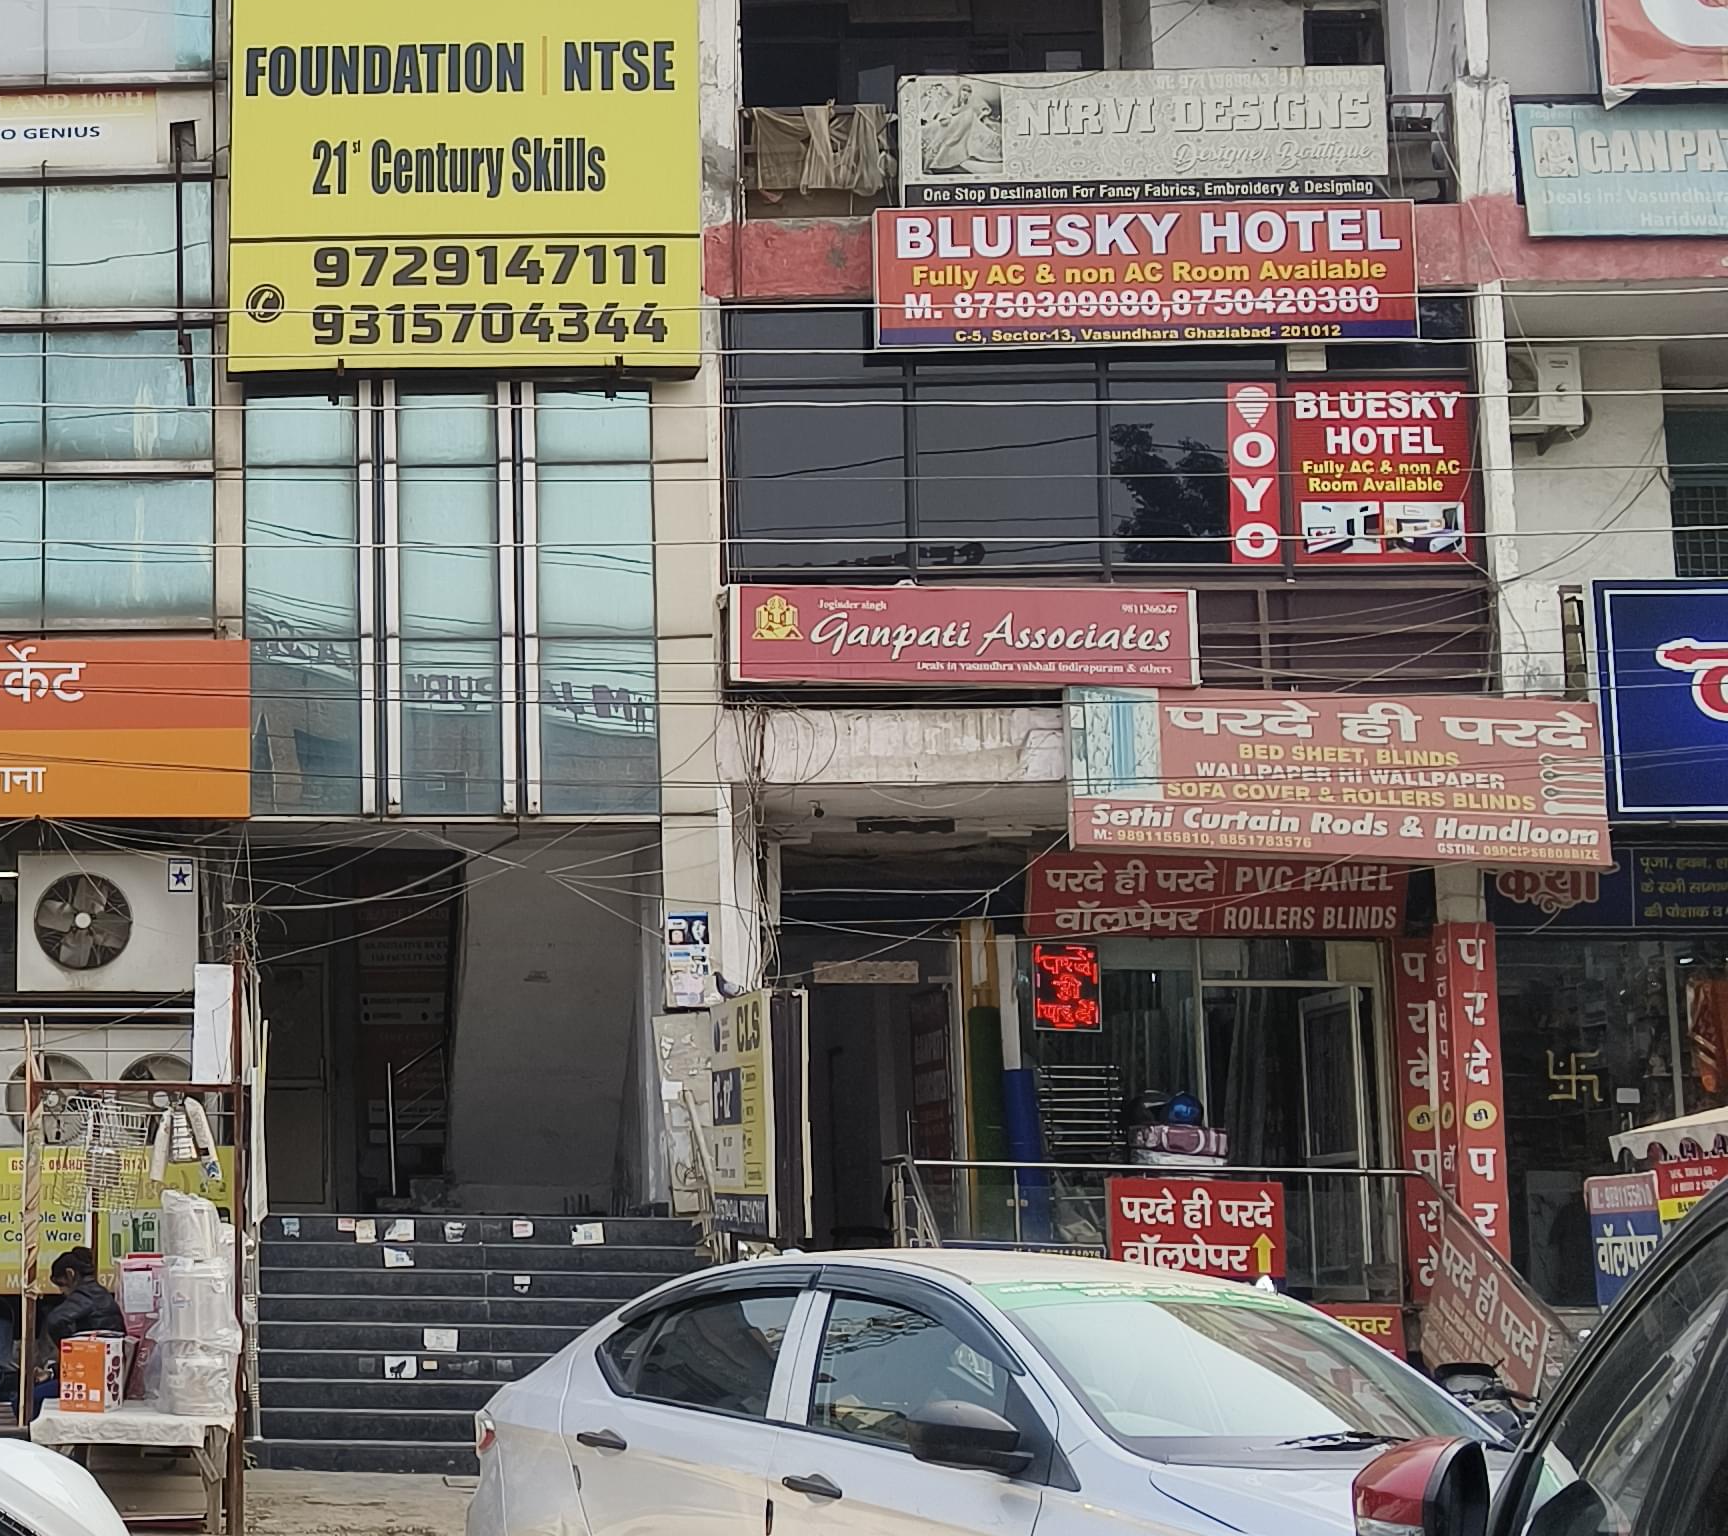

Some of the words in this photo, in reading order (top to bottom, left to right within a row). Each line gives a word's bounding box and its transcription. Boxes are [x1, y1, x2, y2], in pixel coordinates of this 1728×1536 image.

[245, 43, 525, 97] FOUNDATION
[563, 41, 676, 92] NTSE
[23, 125, 101, 140] GENIUS
[1016, 96, 1155, 137] NIRVI
[1173, 91, 1371, 133] DESIGNS
[371, 139, 504, 198] Century
[512, 137, 606, 192] Skills
[989, 185, 1069, 201] Destination
[1073, 185, 1094, 200] For
[1098, 184, 1141, 201] Fancy
[1144, 183, 1200, 200] Fabrics,
[1204, 180, 1285, 199] Embroidery
[896, 212, 1180, 260] BLUESKY
[1201, 209, 1401, 255] HOTEL
[313, 245, 667, 287] 9729147111
[1173, 260, 1249, 283] Room
[1258, 258, 1387, 281] Available
[312, 302, 668, 345] 9315704344
[992, 327, 1076, 345] Sector-13,
[1082, 326, 1180, 341] Vasundhara
[1280, 323, 1342, 338] 201012
[1295, 390, 1460, 421] BLUESKY
[1326, 426, 1444, 455] HOTEL
[1231, 432, 1279, 559] OYO
[1308, 478, 1358, 494] Room
[1363, 477, 1444, 494] Available
[810, 611, 972, 660] Ganpati
[975, 612, 1171, 657] Associates
[1164, 701, 1315, 743] परदे
[1340, 701, 1420, 744] ही
[1441, 710, 1594, 749] परदे
[1290, 745, 1366, 764] SHEET,
[1375, 748, 1460, 766] BLINDS
[1166, 782, 1228, 800] SOFA
[1234, 783, 1312, 803] COVER
[1451, 790, 1536, 812] BLINDS
[1091, 803, 1175, 828] Sethi
[1182, 806, 1301, 834] Curtain
[1310, 810, 1389, 838] Rods
[1434, 816, 1600, 846] Handloom
[1045, 861, 1106, 894] परदे
[1113, 860, 1148, 894] ही
[1156, 860, 1215, 894] परदे
[1235, 866, 1292, 893] PVC
[1304, 866, 1394, 892] PANEL
[1223, 904, 1314, 930] ROLLERS
[1322, 903, 1397, 929] BLINDS
[736, 1001, 760, 1052] CLS
[1121, 1187, 1176, 1226] परदे
[1182, 1185, 1213, 1229] ही
[1218, 1190, 1274, 1228] परदे
